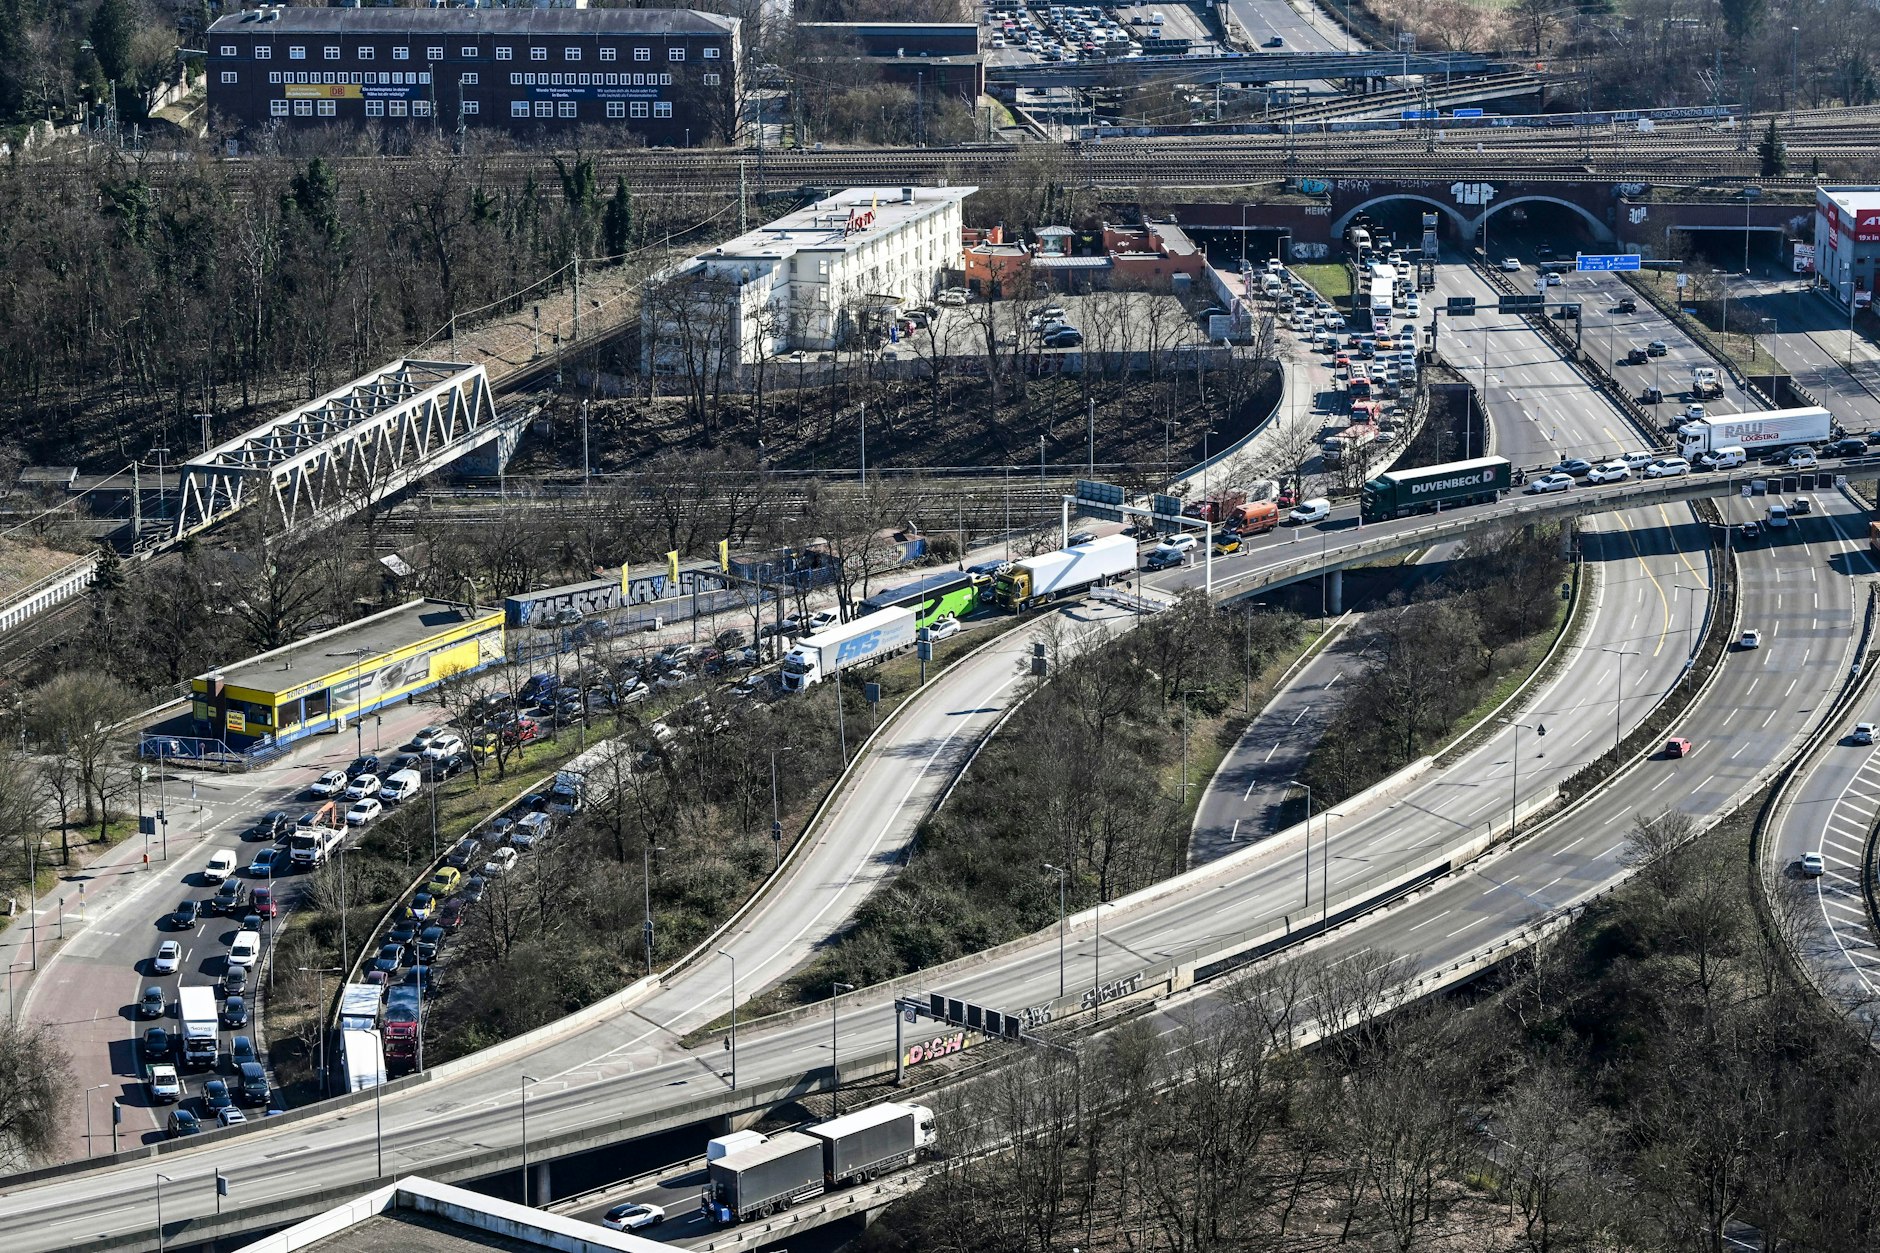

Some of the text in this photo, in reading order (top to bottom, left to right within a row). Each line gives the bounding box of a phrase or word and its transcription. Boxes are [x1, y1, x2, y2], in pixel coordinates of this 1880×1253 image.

[331, 87, 344, 96] DB
[1724, 422, 1763, 439] RALU
[1411, 474, 1481, 495] DUVENBECK
